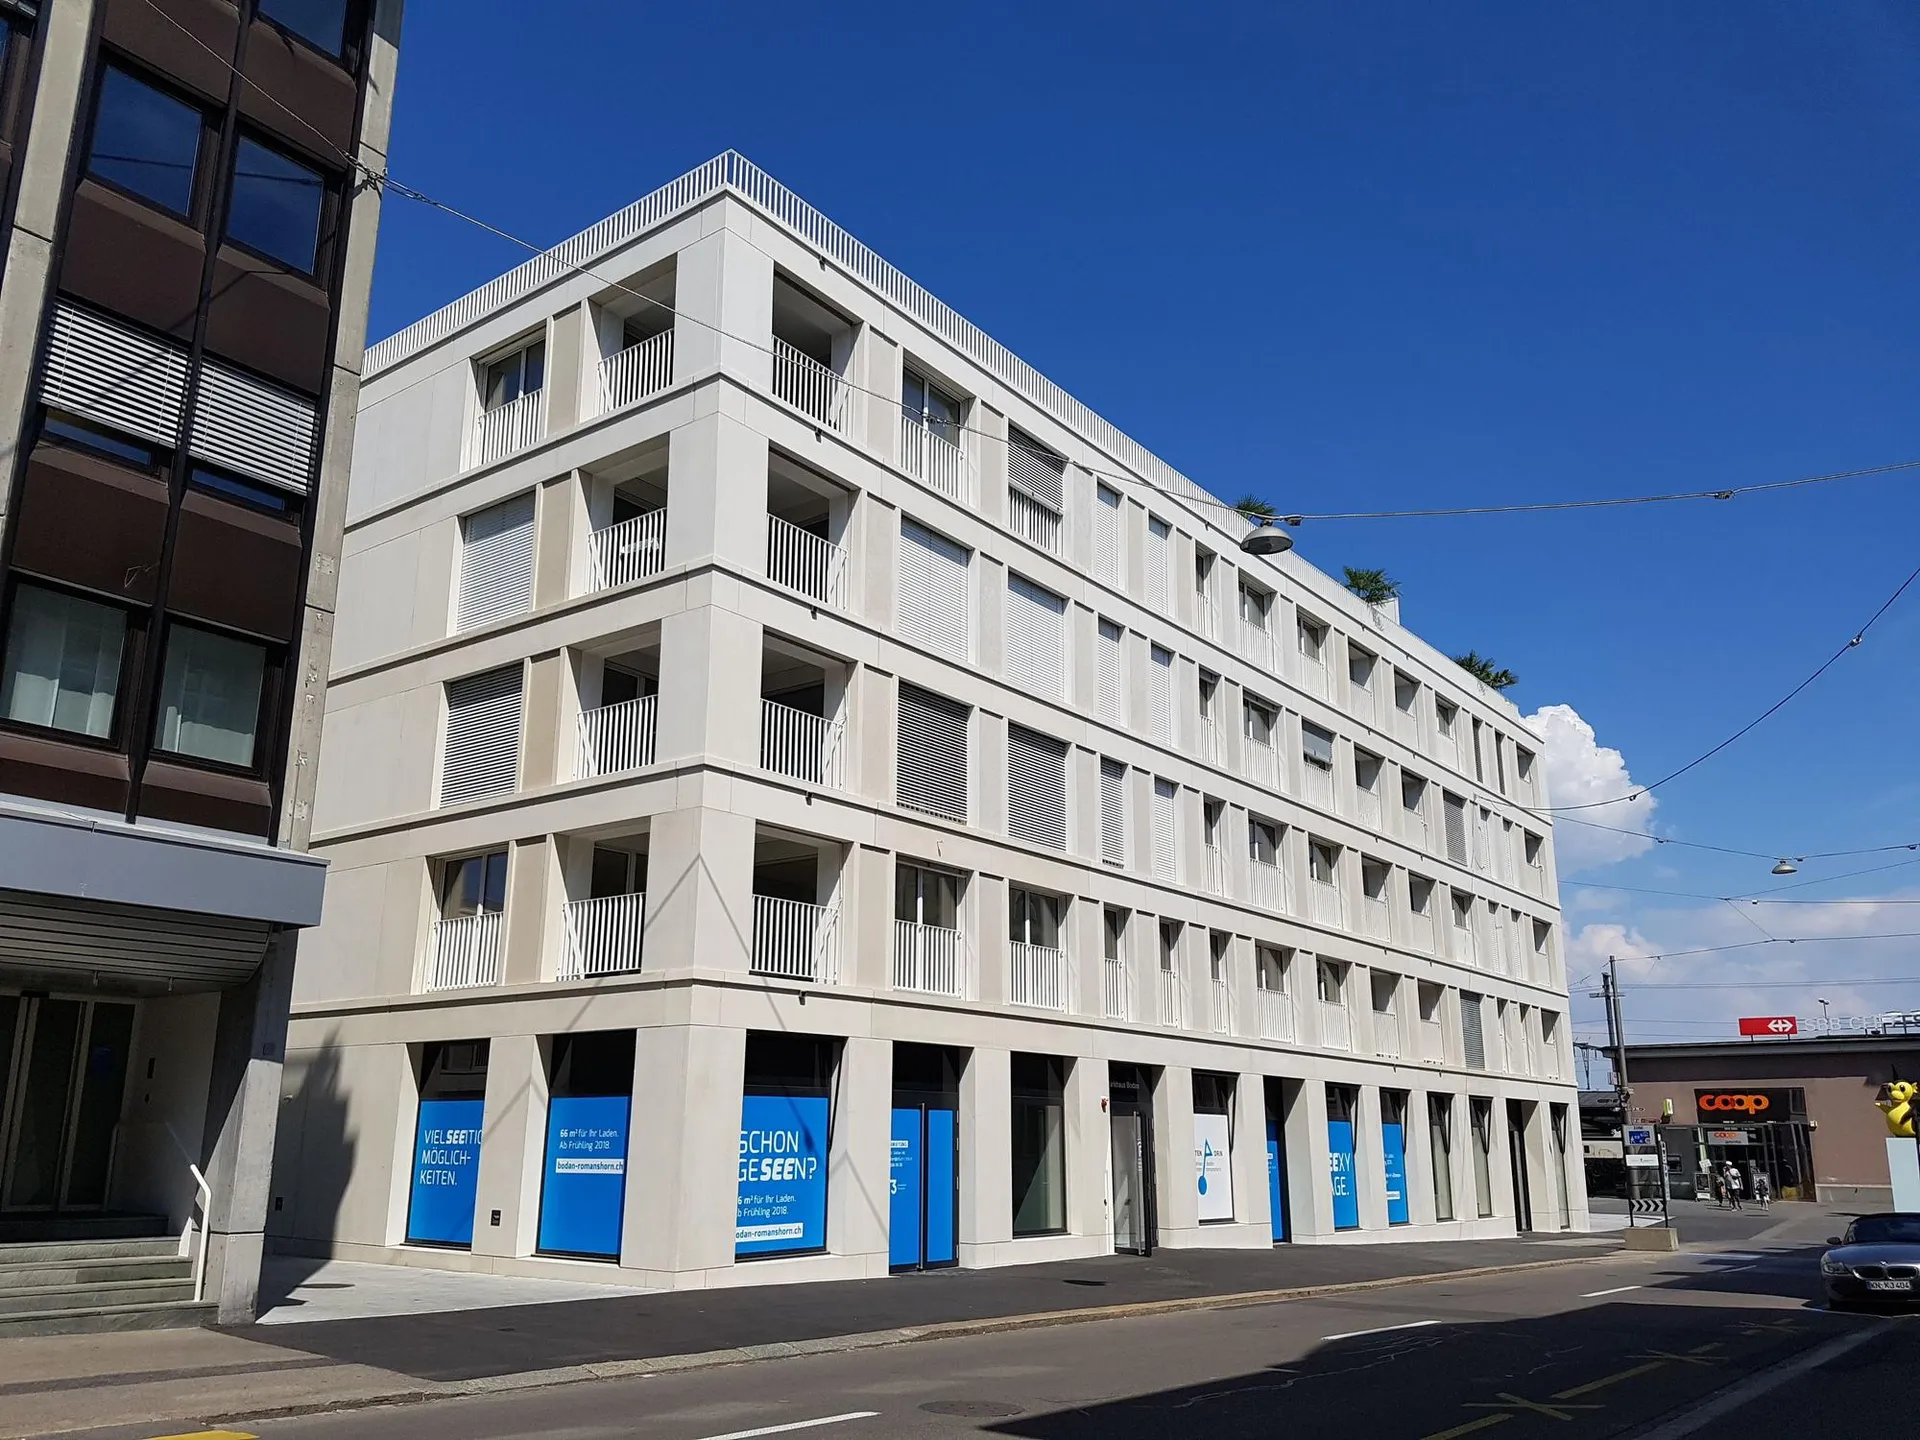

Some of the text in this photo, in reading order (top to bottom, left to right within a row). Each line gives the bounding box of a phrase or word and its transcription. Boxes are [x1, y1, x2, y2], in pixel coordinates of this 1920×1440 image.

[559, 1141, 567, 1149] Ab
[568, 1140, 593, 1151] Frühling
[739, 1130, 799, 1153] SCHON
[421, 1147, 471, 1165] MÖGLICH-
[557, 1161, 624, 1170] bodan-romanshorn.ch
[738, 1157, 817, 1182] GESEEN?
[419, 1169, 457, 1186] KEITEN.
[754, 1195, 764, 1204] für
[765, 1195, 774, 1203] Ihr
[775, 1194, 796, 1203] Laden.
[743, 1207, 770, 1218] Frühling
[772, 1206, 789, 1216] 2018.
[735, 1226, 802, 1239] odan-romanshorn.ch
